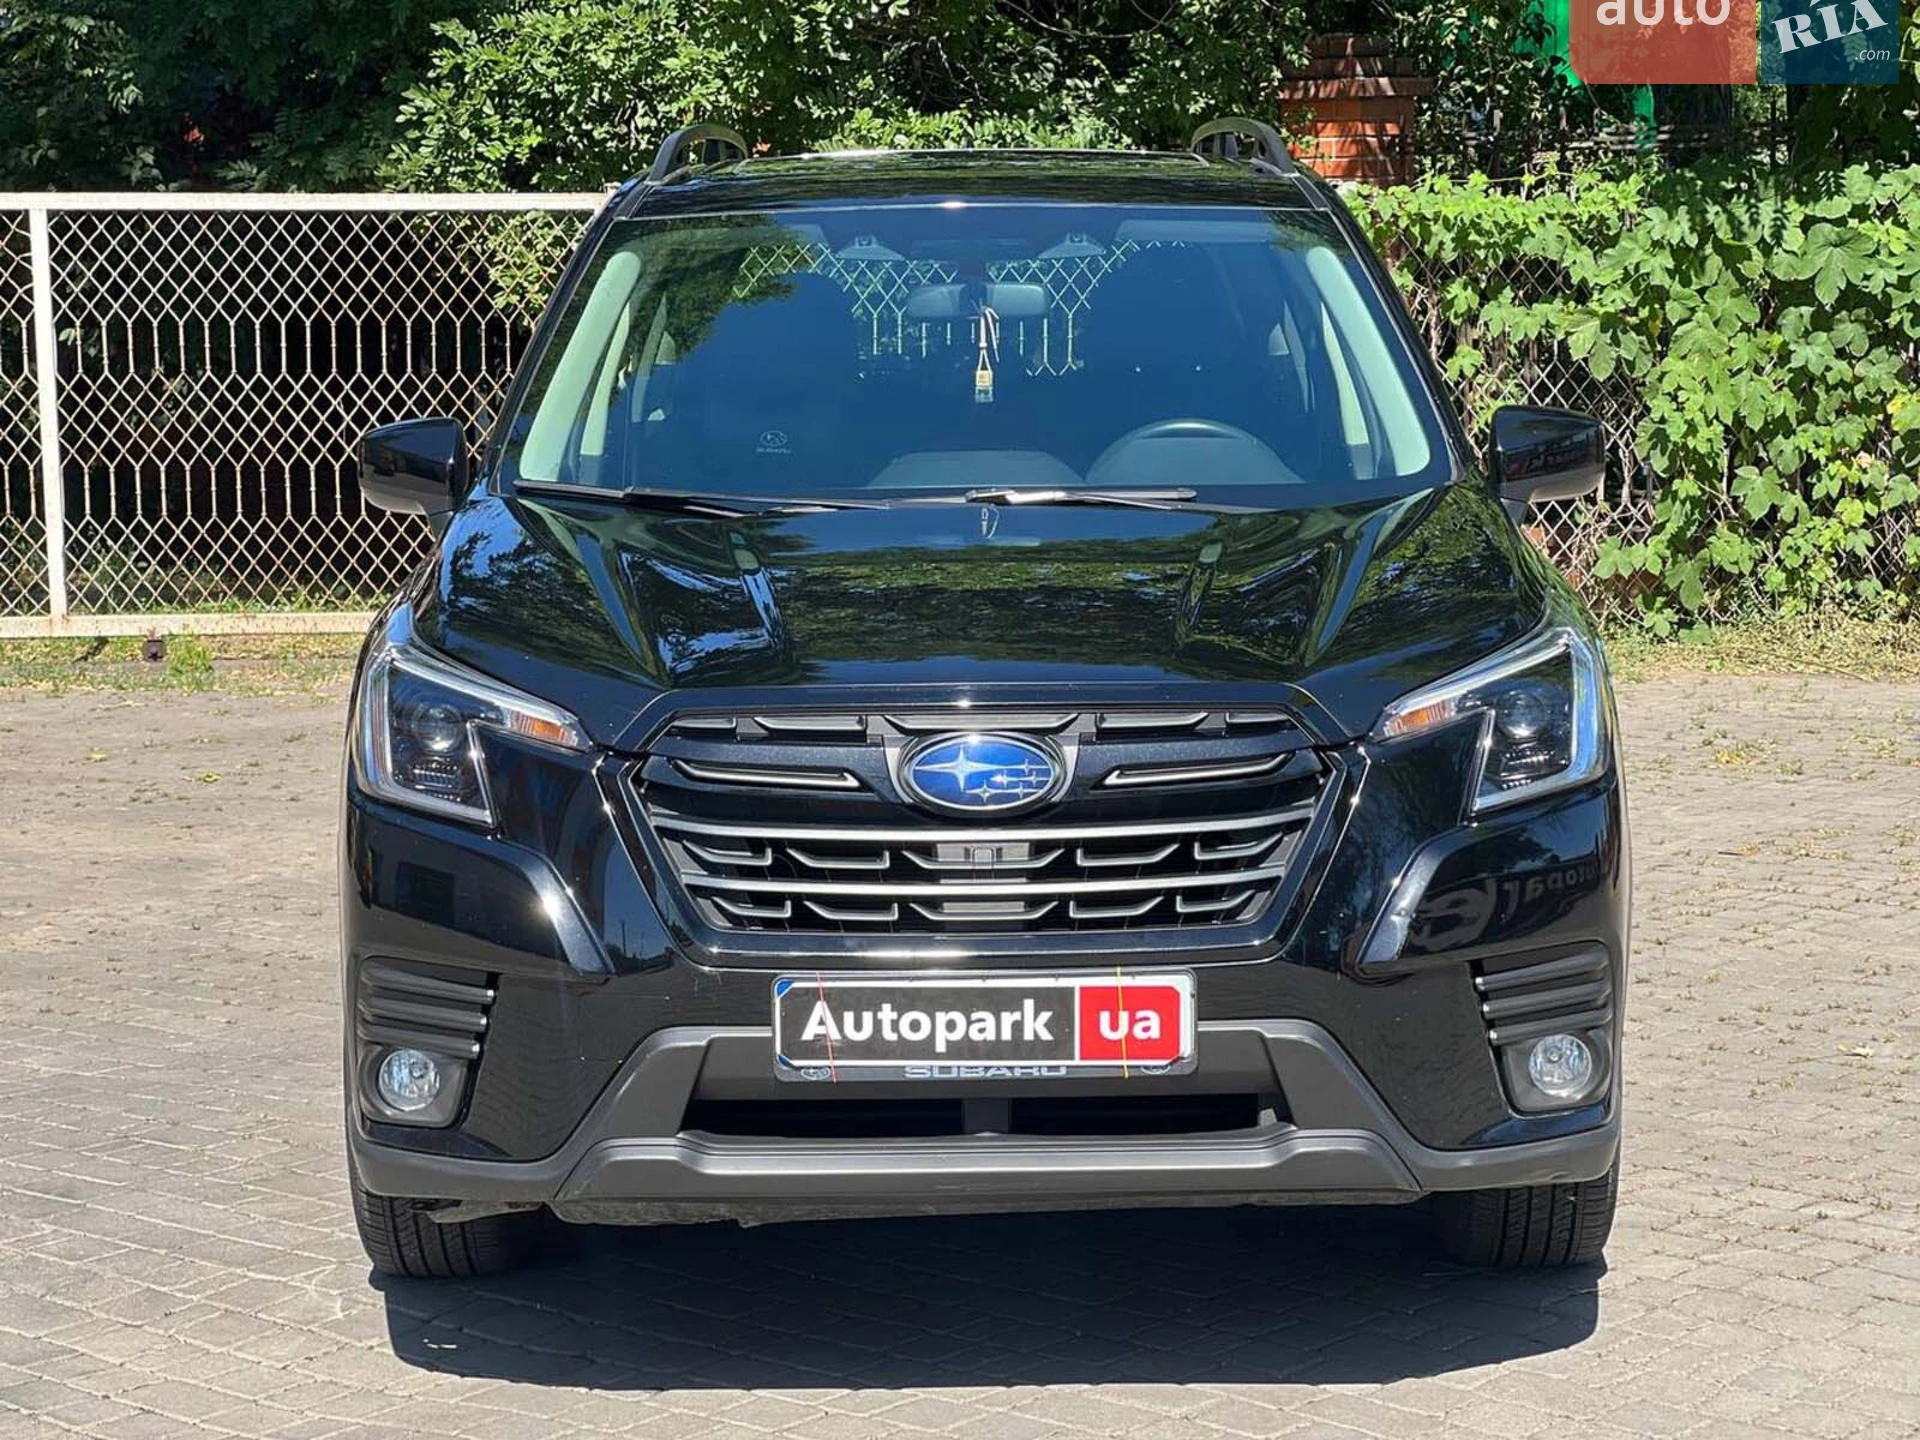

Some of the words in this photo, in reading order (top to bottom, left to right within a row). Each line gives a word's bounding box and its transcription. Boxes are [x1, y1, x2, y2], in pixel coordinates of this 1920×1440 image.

[800, 998, 1054, 1053] Autopark
[1098, 1009, 1161, 1041] ua
[904, 1065, 1067, 1078] SUBARU
